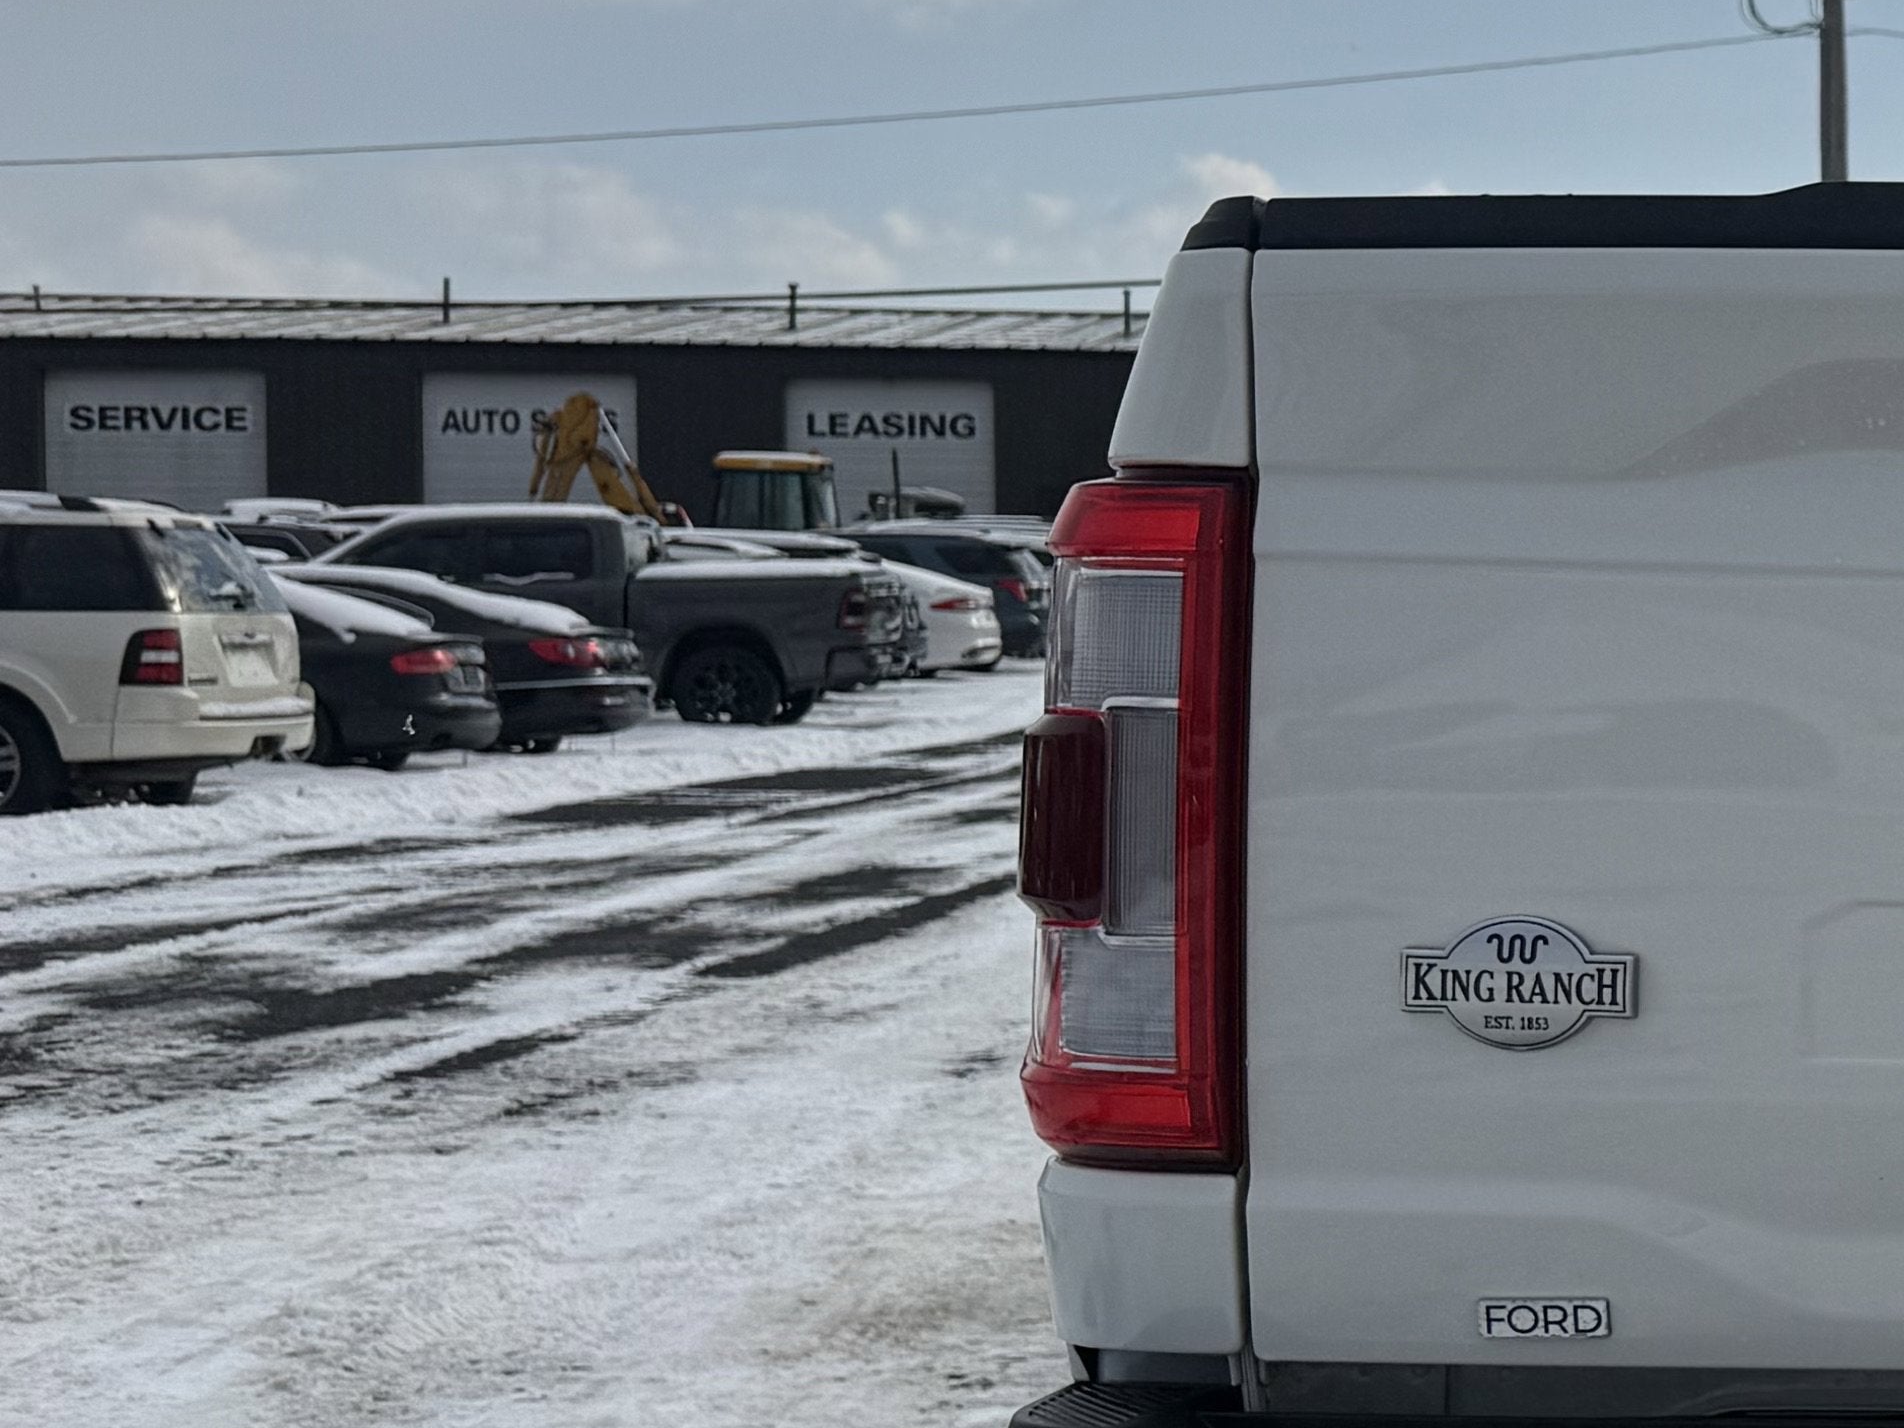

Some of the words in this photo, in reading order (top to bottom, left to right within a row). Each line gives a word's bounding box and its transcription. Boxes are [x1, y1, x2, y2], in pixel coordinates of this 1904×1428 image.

[69, 404, 249, 433] SERVICE
[442, 409, 521, 434] AUTO
[806, 411, 977, 440] LEASING
[1412, 962, 1495, 1003] KING
[1505, 967, 1620, 1007] RANCH
[1484, 1015, 1516, 1031] EST.
[1520, 1016, 1550, 1031] 1853
[1485, 1304, 1603, 1335] FORD
